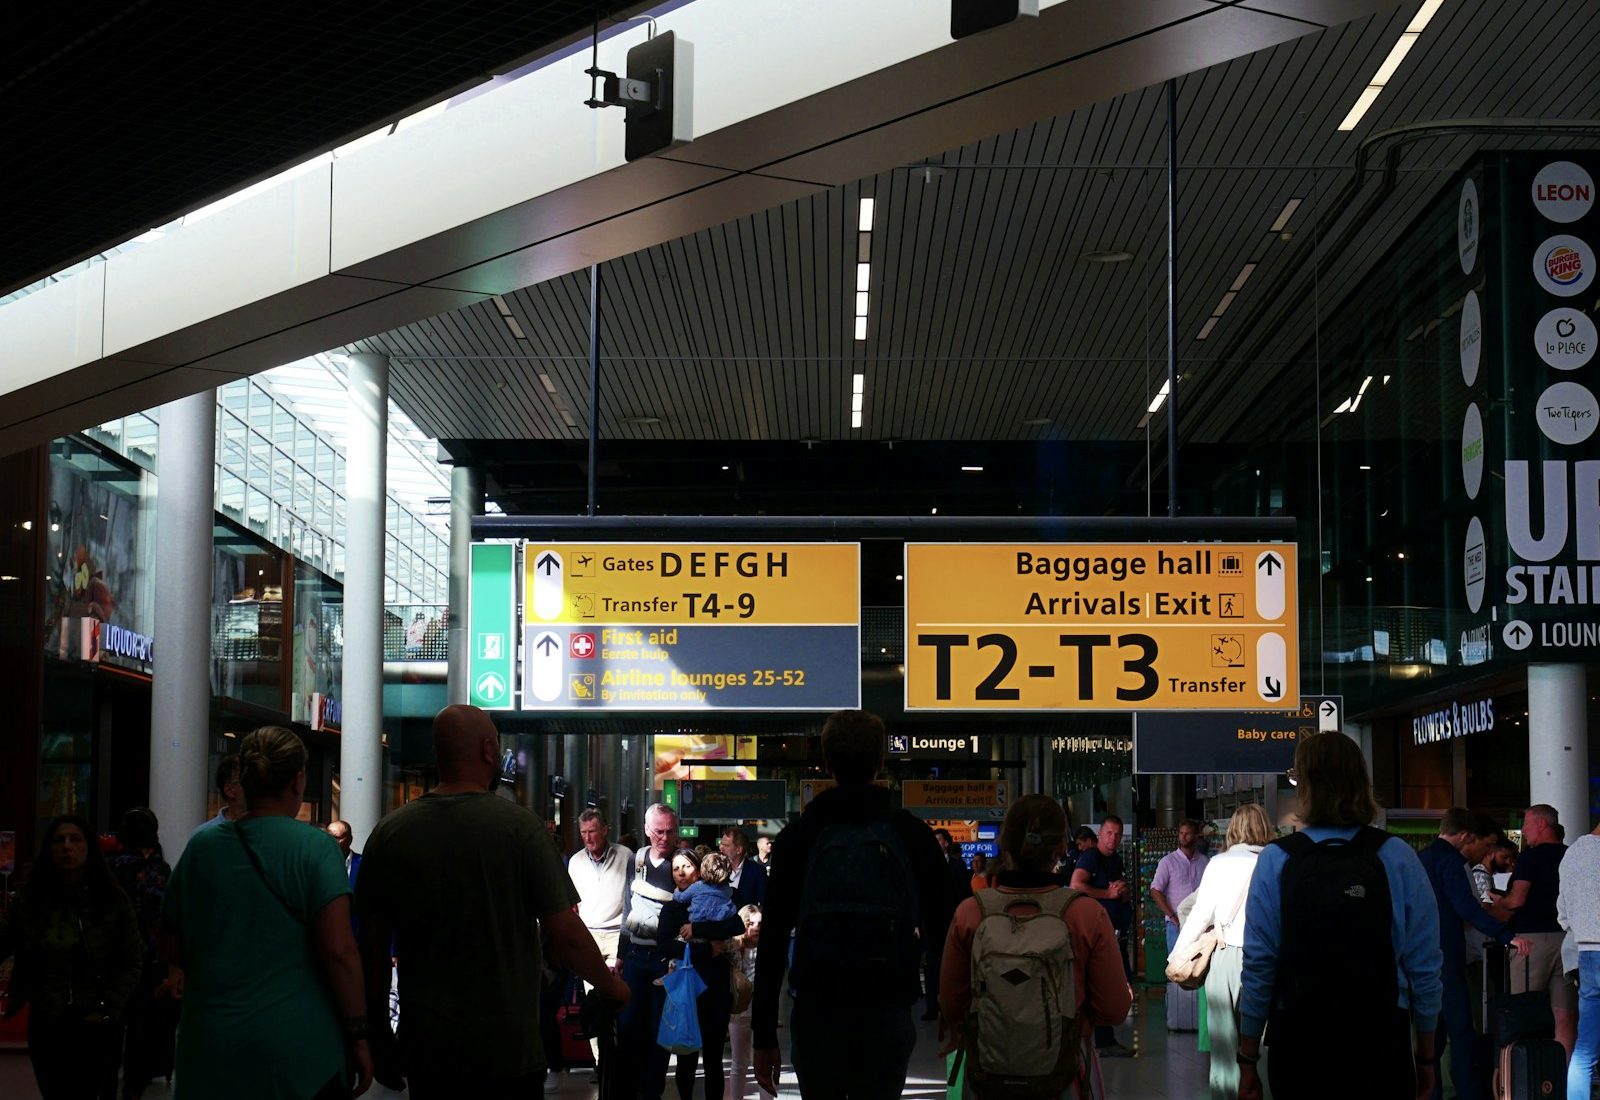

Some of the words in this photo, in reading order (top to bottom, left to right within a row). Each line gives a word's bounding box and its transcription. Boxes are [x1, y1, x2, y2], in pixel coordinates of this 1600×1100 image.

[1537, 184, 1589, 201] LEON
[1548, 252, 1580, 267] BURGER
[1550, 260, 1581, 277] KING
[1558, 342, 1586, 354] PLACE
[602, 557, 654, 571] Gates
[1016, 552, 1147, 581] Baggage
[1157, 550, 1212, 575] hall
[602, 596, 678, 612] Transfer
[682, 593, 756, 618] T4-9
[1024, 592, 1141, 616] Arrivals
[1155, 592, 1212, 616] Exit
[105, 624, 138, 657] LIQUOR
[139, 634, 146, 661] &
[601, 629, 643, 645] First
[648, 629, 678, 645] aid
[1541, 622, 1600, 647] LOUN
[601, 649, 639, 660] Eerste
[641, 648, 669, 661] hulp
[917, 634, 1160, 702] T2-T3
[601, 669, 666, 686] Airline
[671, 669, 747, 690] lounges
[752, 670, 805, 686] 25-52
[1168, 677, 1247, 693] Transfer
[601, 690, 615, 703] By
[619, 690, 677, 702] invitation
[680, 690, 707, 703] only
[1413, 708, 1452, 746] FLOWERS
[1452, 701, 1461, 738] &
[1461, 698, 1494, 736] BULBS
[1237, 728, 1267, 742] Baby
[1271, 731, 1296, 740] care
[912, 736, 966, 751] Lounge
[969, 735, 979, 753] 1
[922, 784, 964, 793] Baggage
[967, 783, 985, 792] hall
[925, 796, 962, 805] Arrivals
[966, 796, 983, 805] Exit
